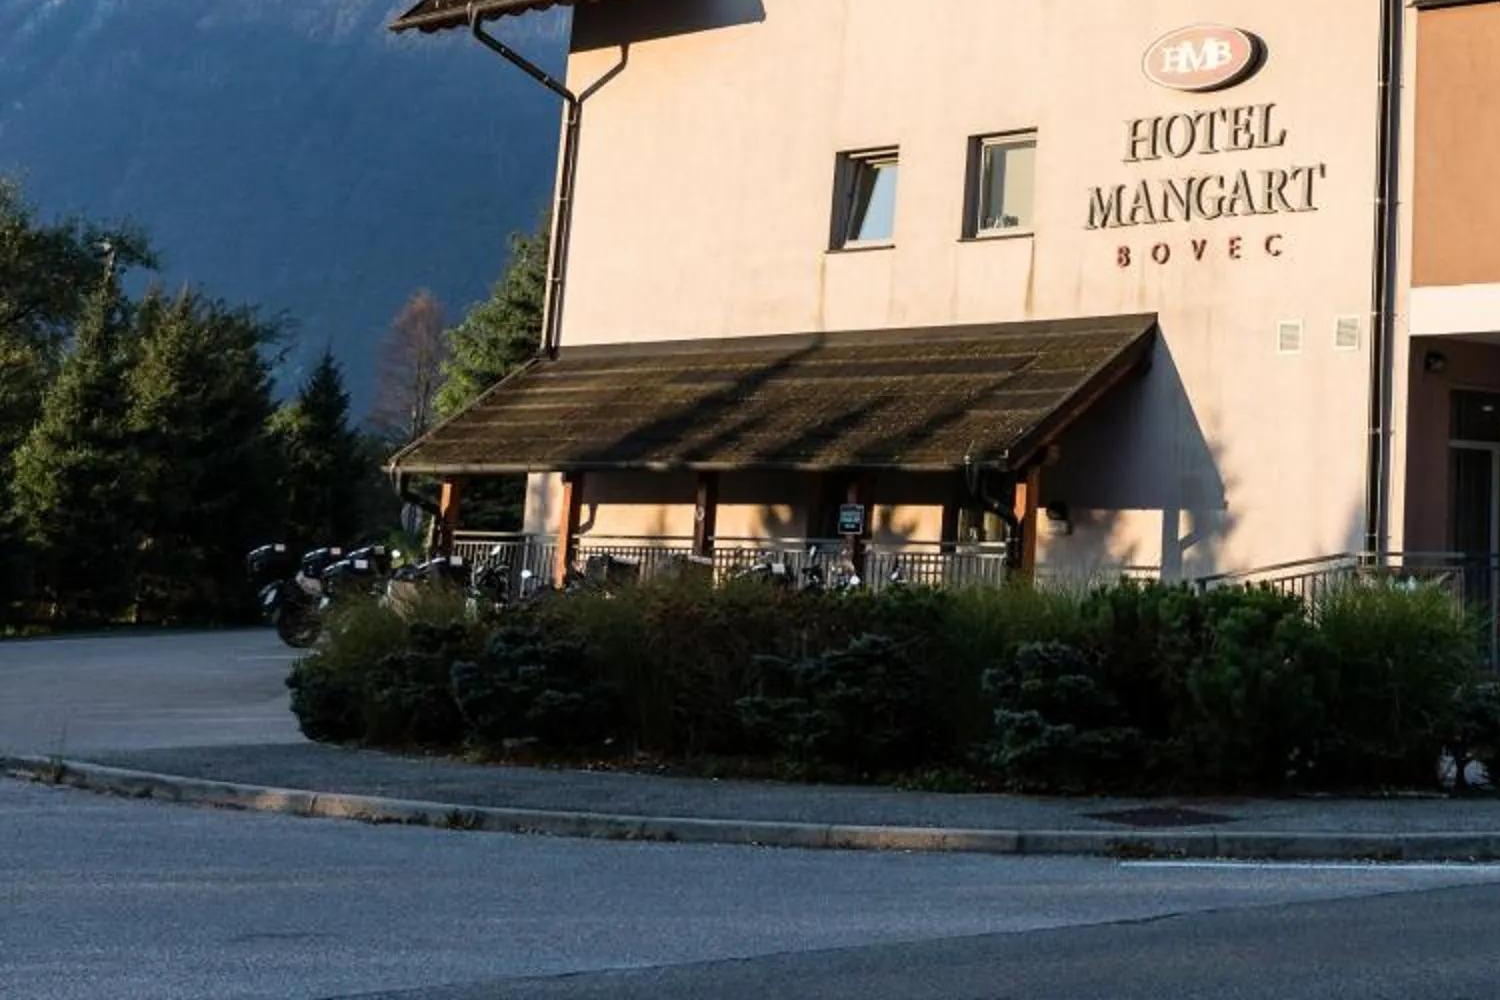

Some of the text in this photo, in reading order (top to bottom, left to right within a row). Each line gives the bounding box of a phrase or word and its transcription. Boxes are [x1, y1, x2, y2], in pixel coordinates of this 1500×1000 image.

[1162, 37, 1232, 73] HMB
[1122, 103, 1287, 162] HOTEL
[1085, 163, 1326, 229] MANGART
[1117, 234, 1283, 267] BOVEC
